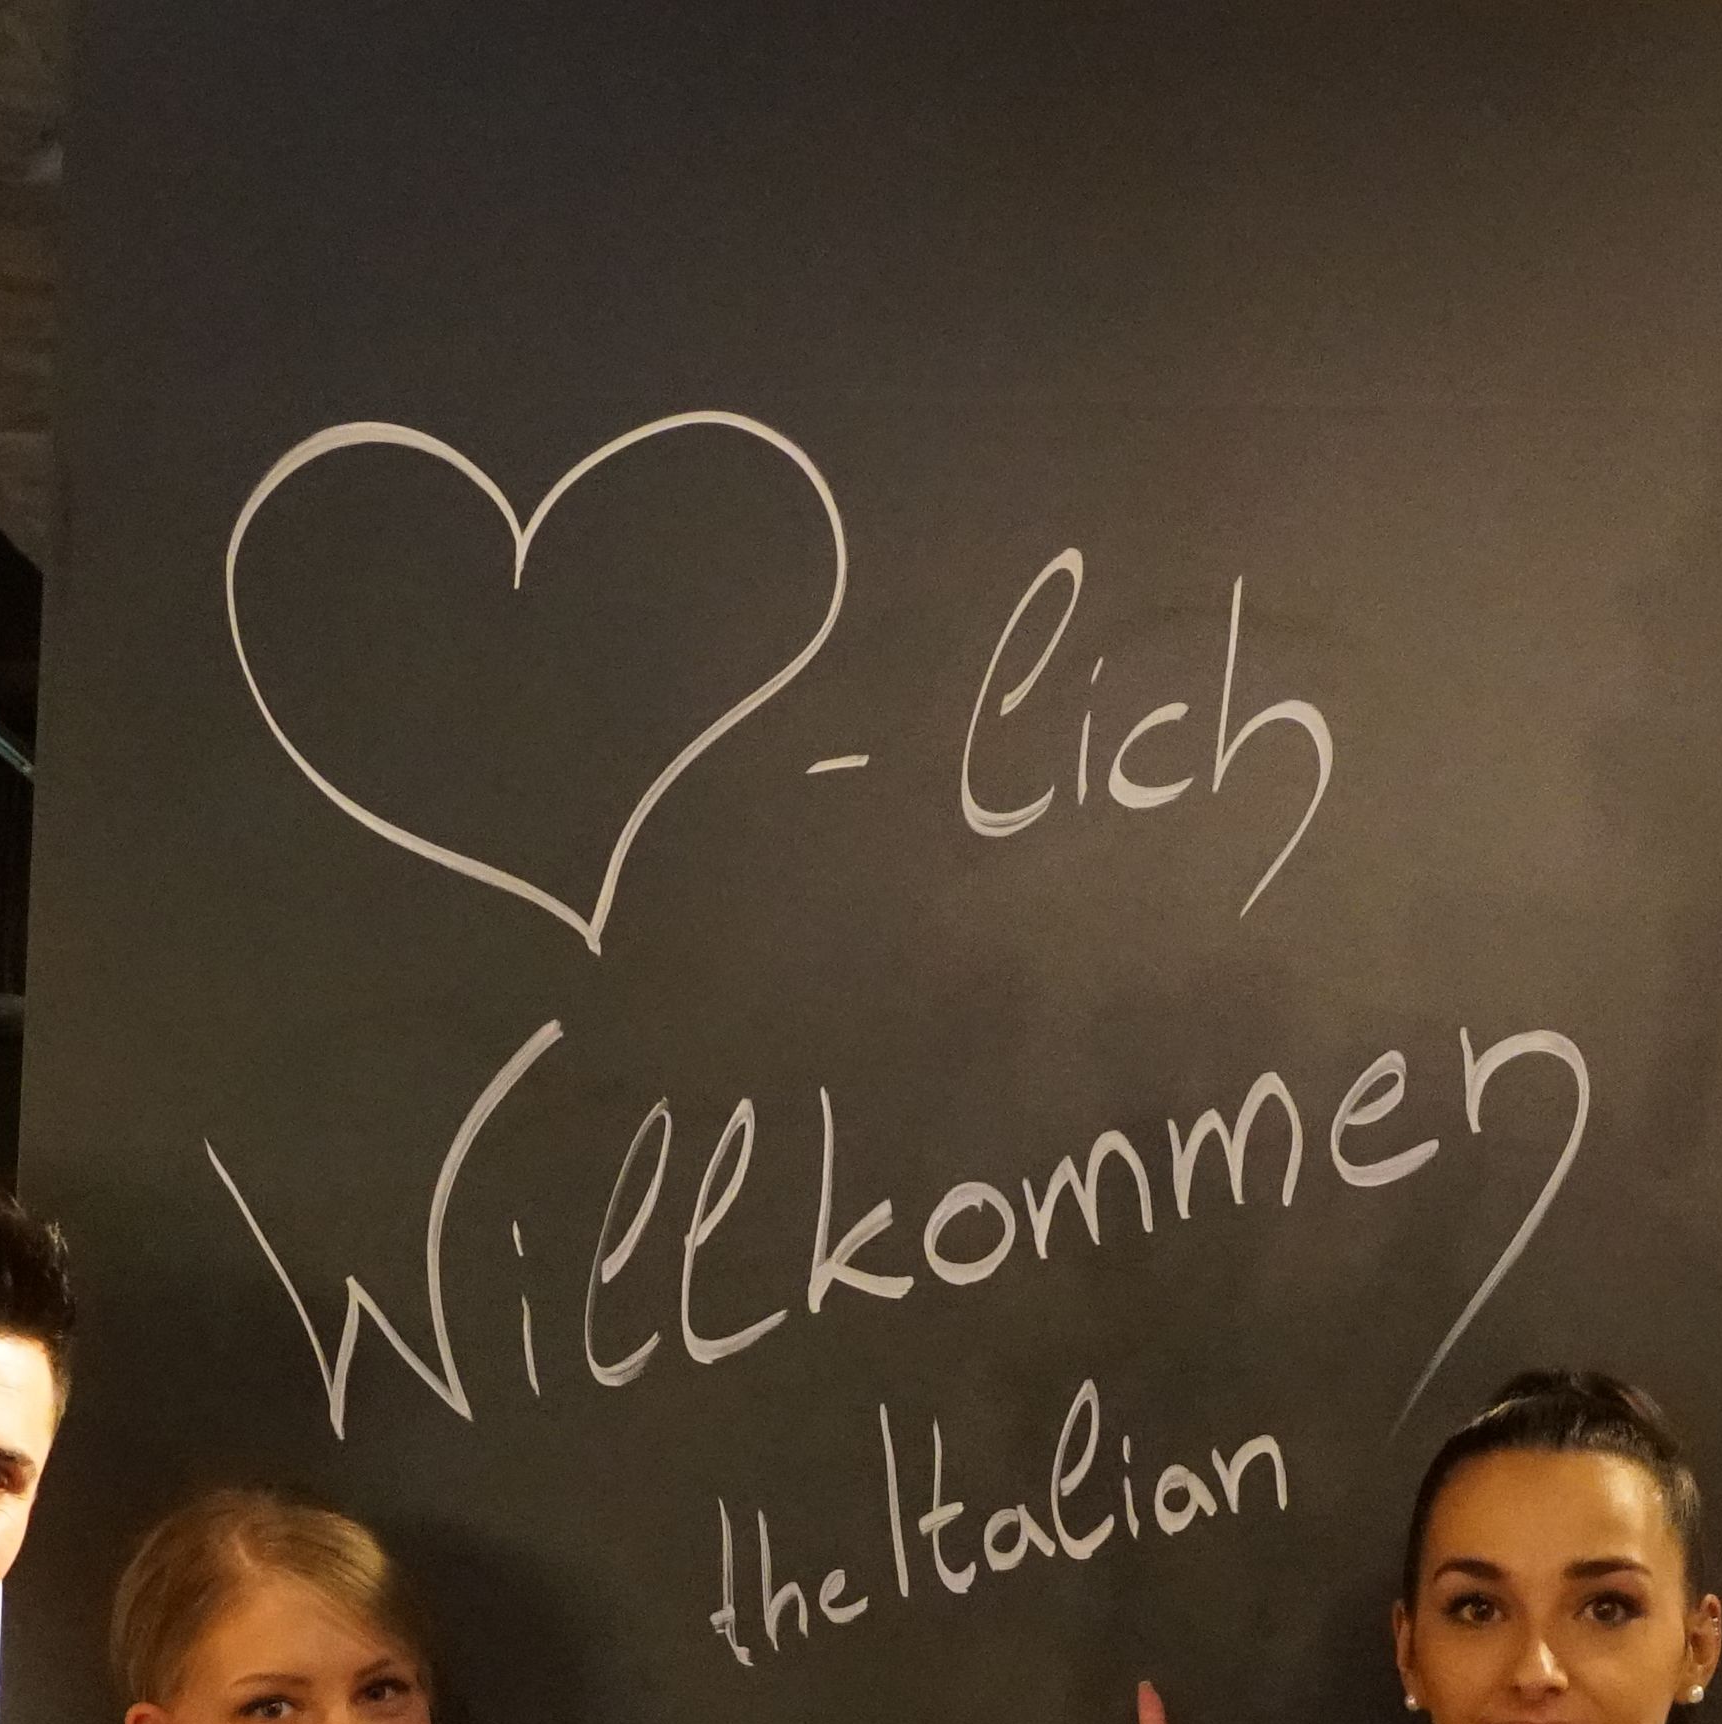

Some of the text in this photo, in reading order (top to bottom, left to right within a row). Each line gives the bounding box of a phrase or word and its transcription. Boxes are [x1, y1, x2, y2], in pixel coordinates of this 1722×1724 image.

[203, 1018, 1591, 1442] Willkommen
[709, 1378, 1289, 1668] the Italian
